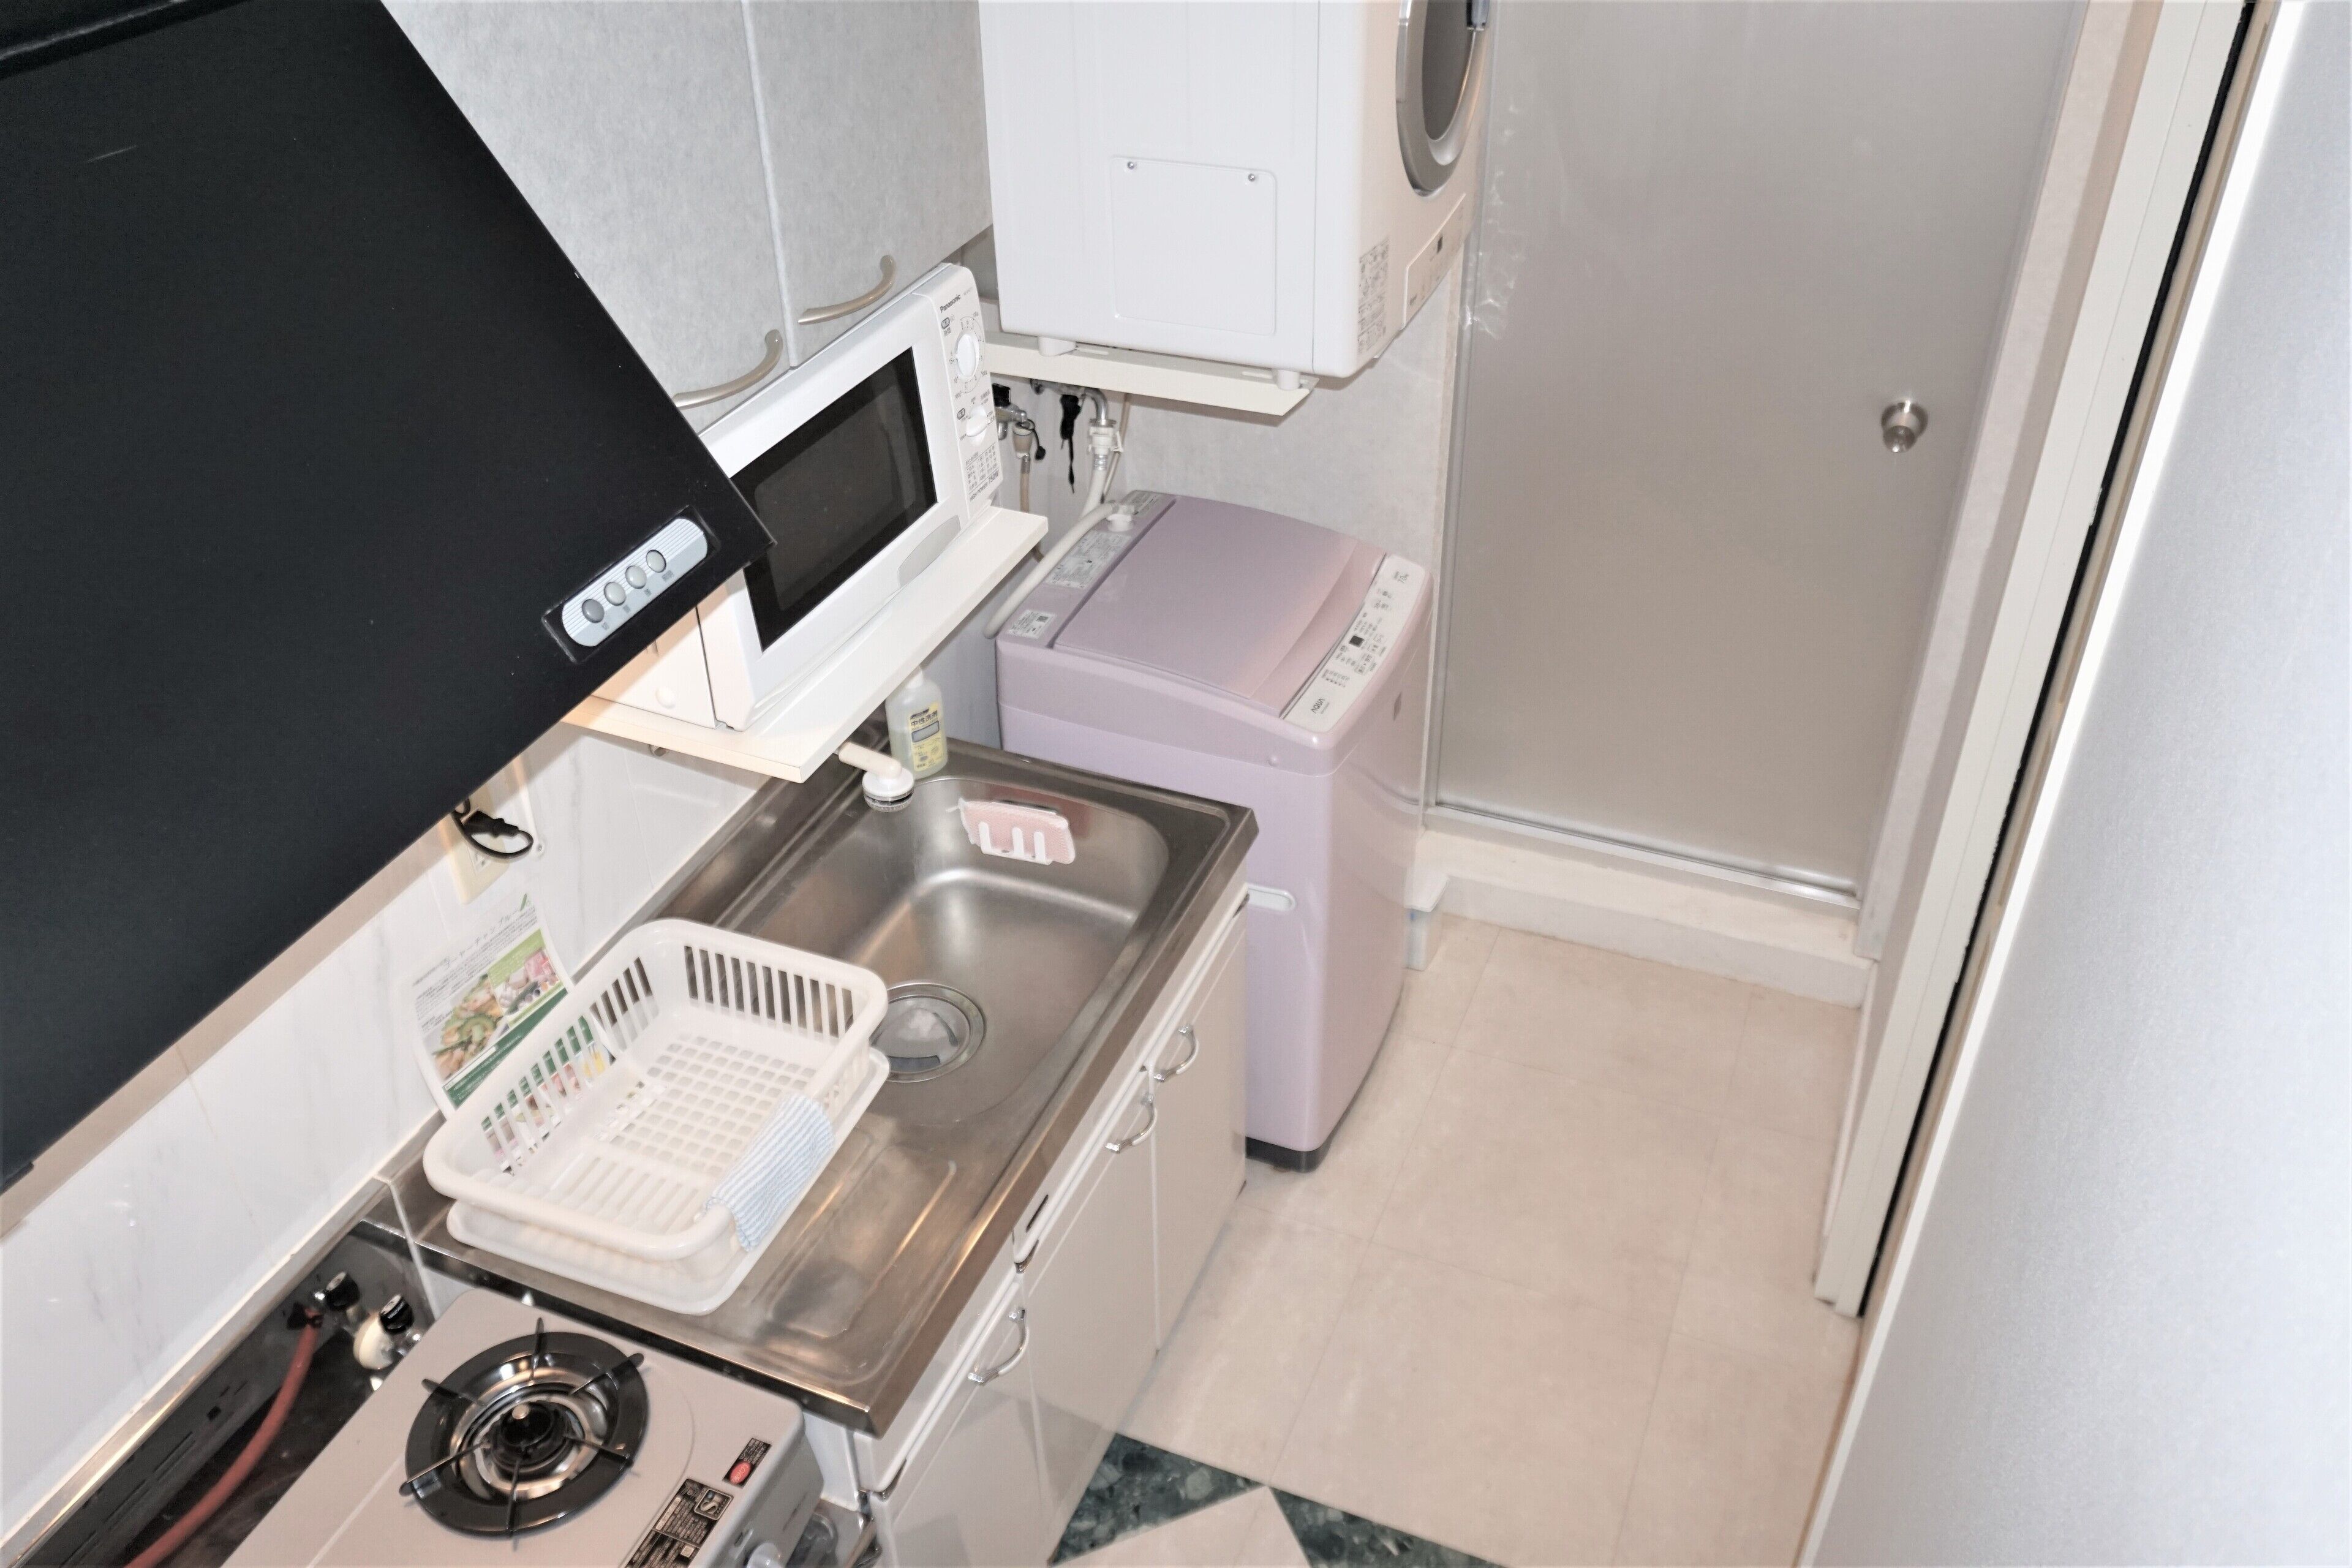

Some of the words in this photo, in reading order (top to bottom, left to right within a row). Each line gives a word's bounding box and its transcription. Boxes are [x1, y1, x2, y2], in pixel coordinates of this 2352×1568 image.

[940, 295, 961, 313] Panasonic
[988, 469, 1000, 484] 750W
[1311, 698, 1325, 714] AQUA
[911, 710, 938, 726] 中性洗剤
